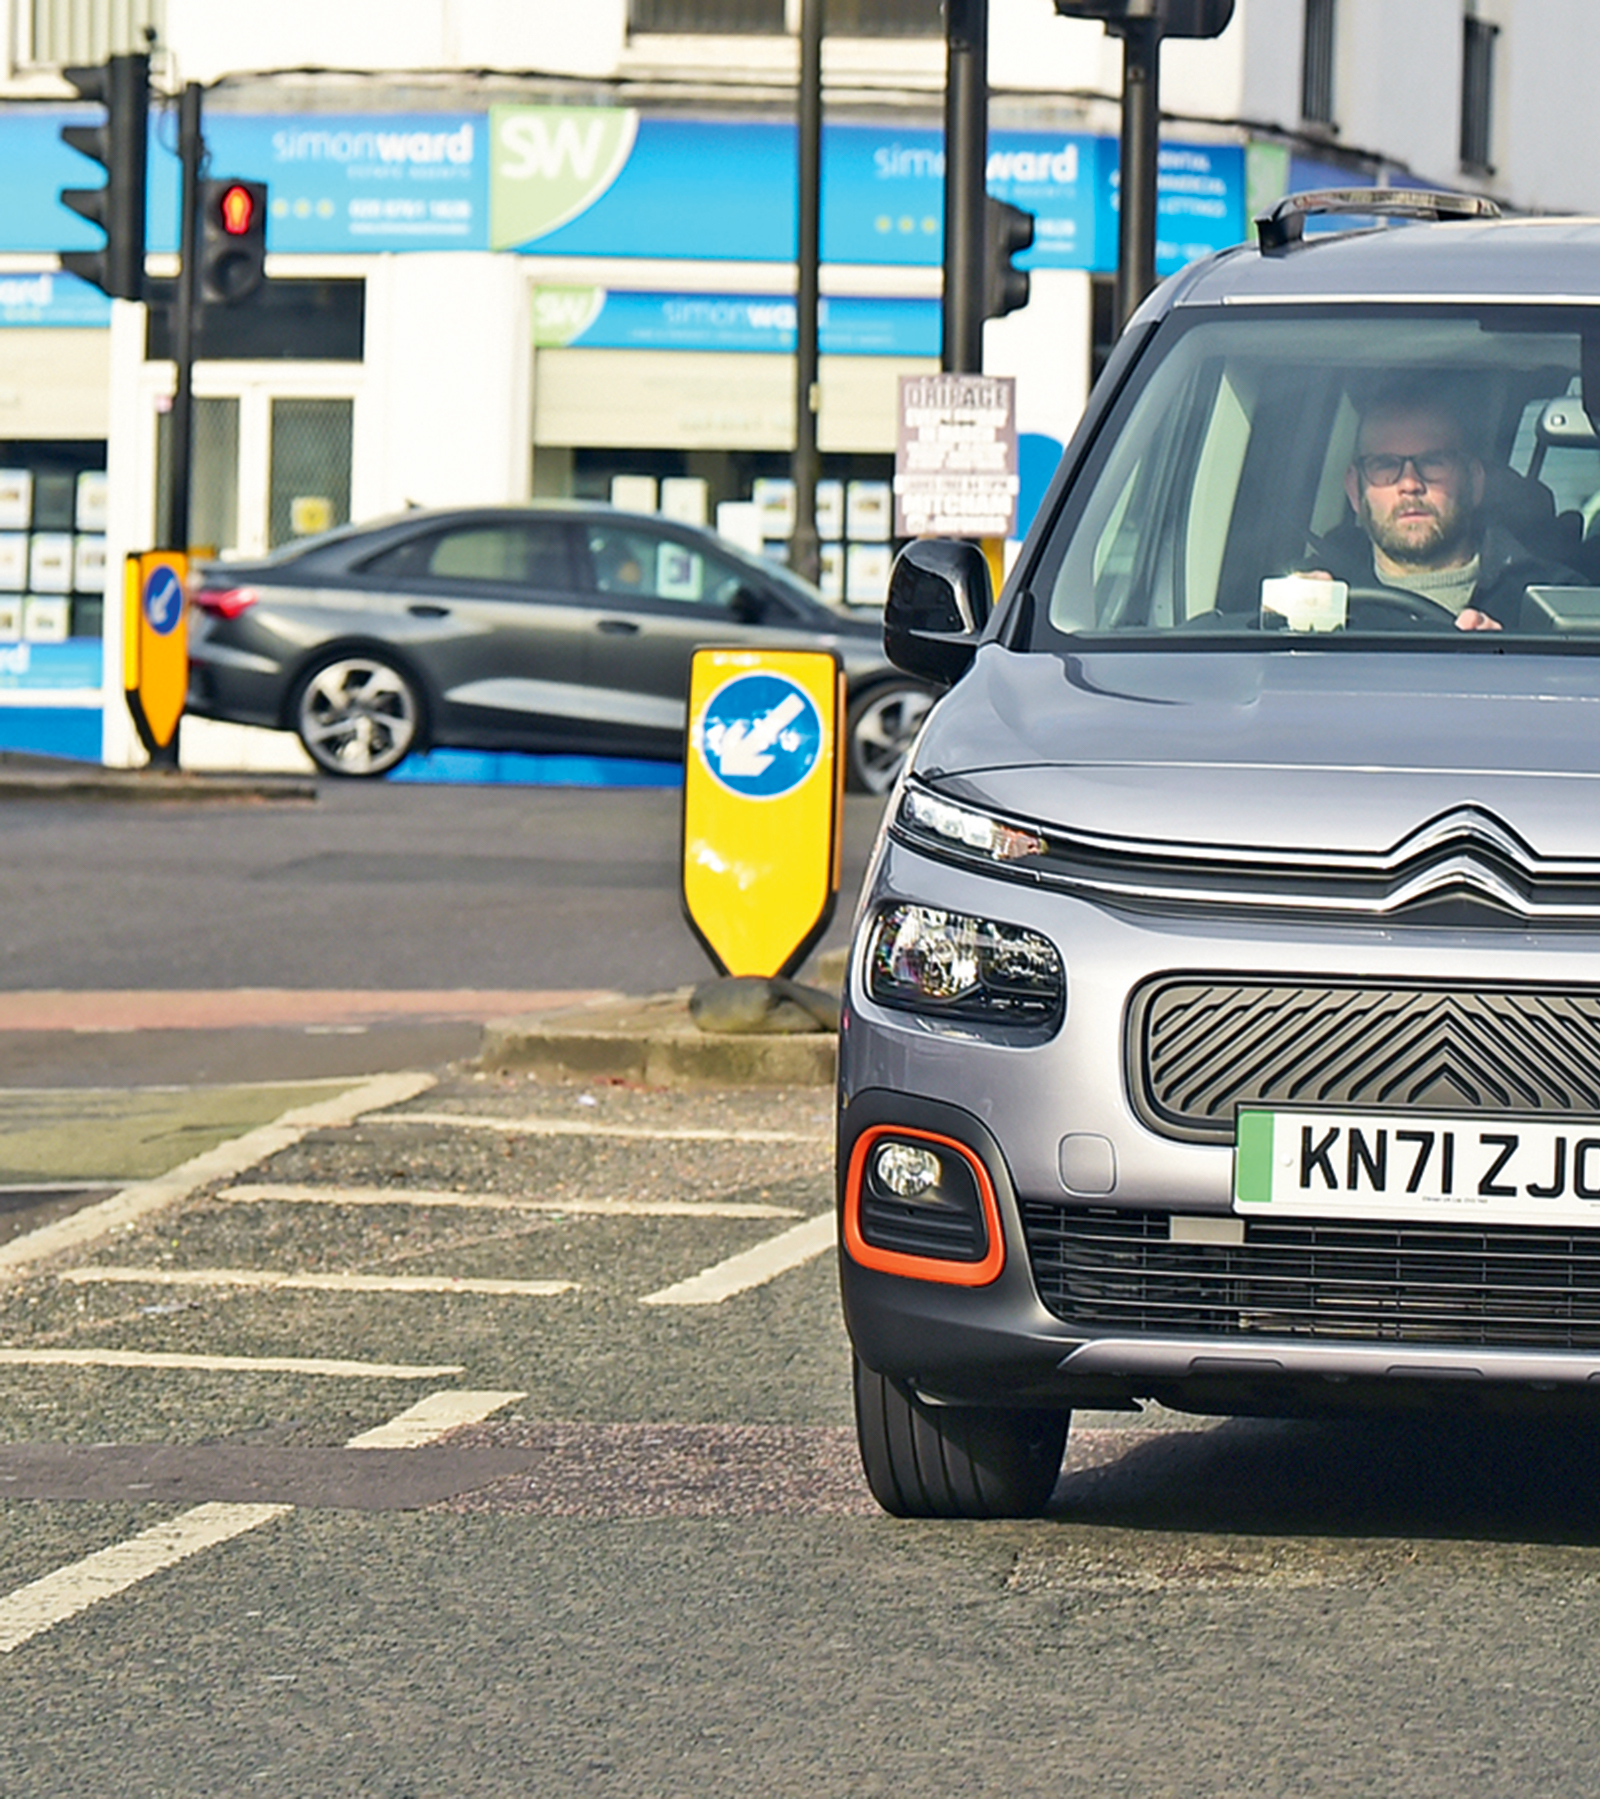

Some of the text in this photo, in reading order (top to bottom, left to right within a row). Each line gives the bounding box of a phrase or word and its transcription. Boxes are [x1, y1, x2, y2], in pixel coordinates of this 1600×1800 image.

[500, 116, 605, 181] SW
[874, 143, 1077, 182] simward
[1299, 1126, 1455, 1194] KN71
